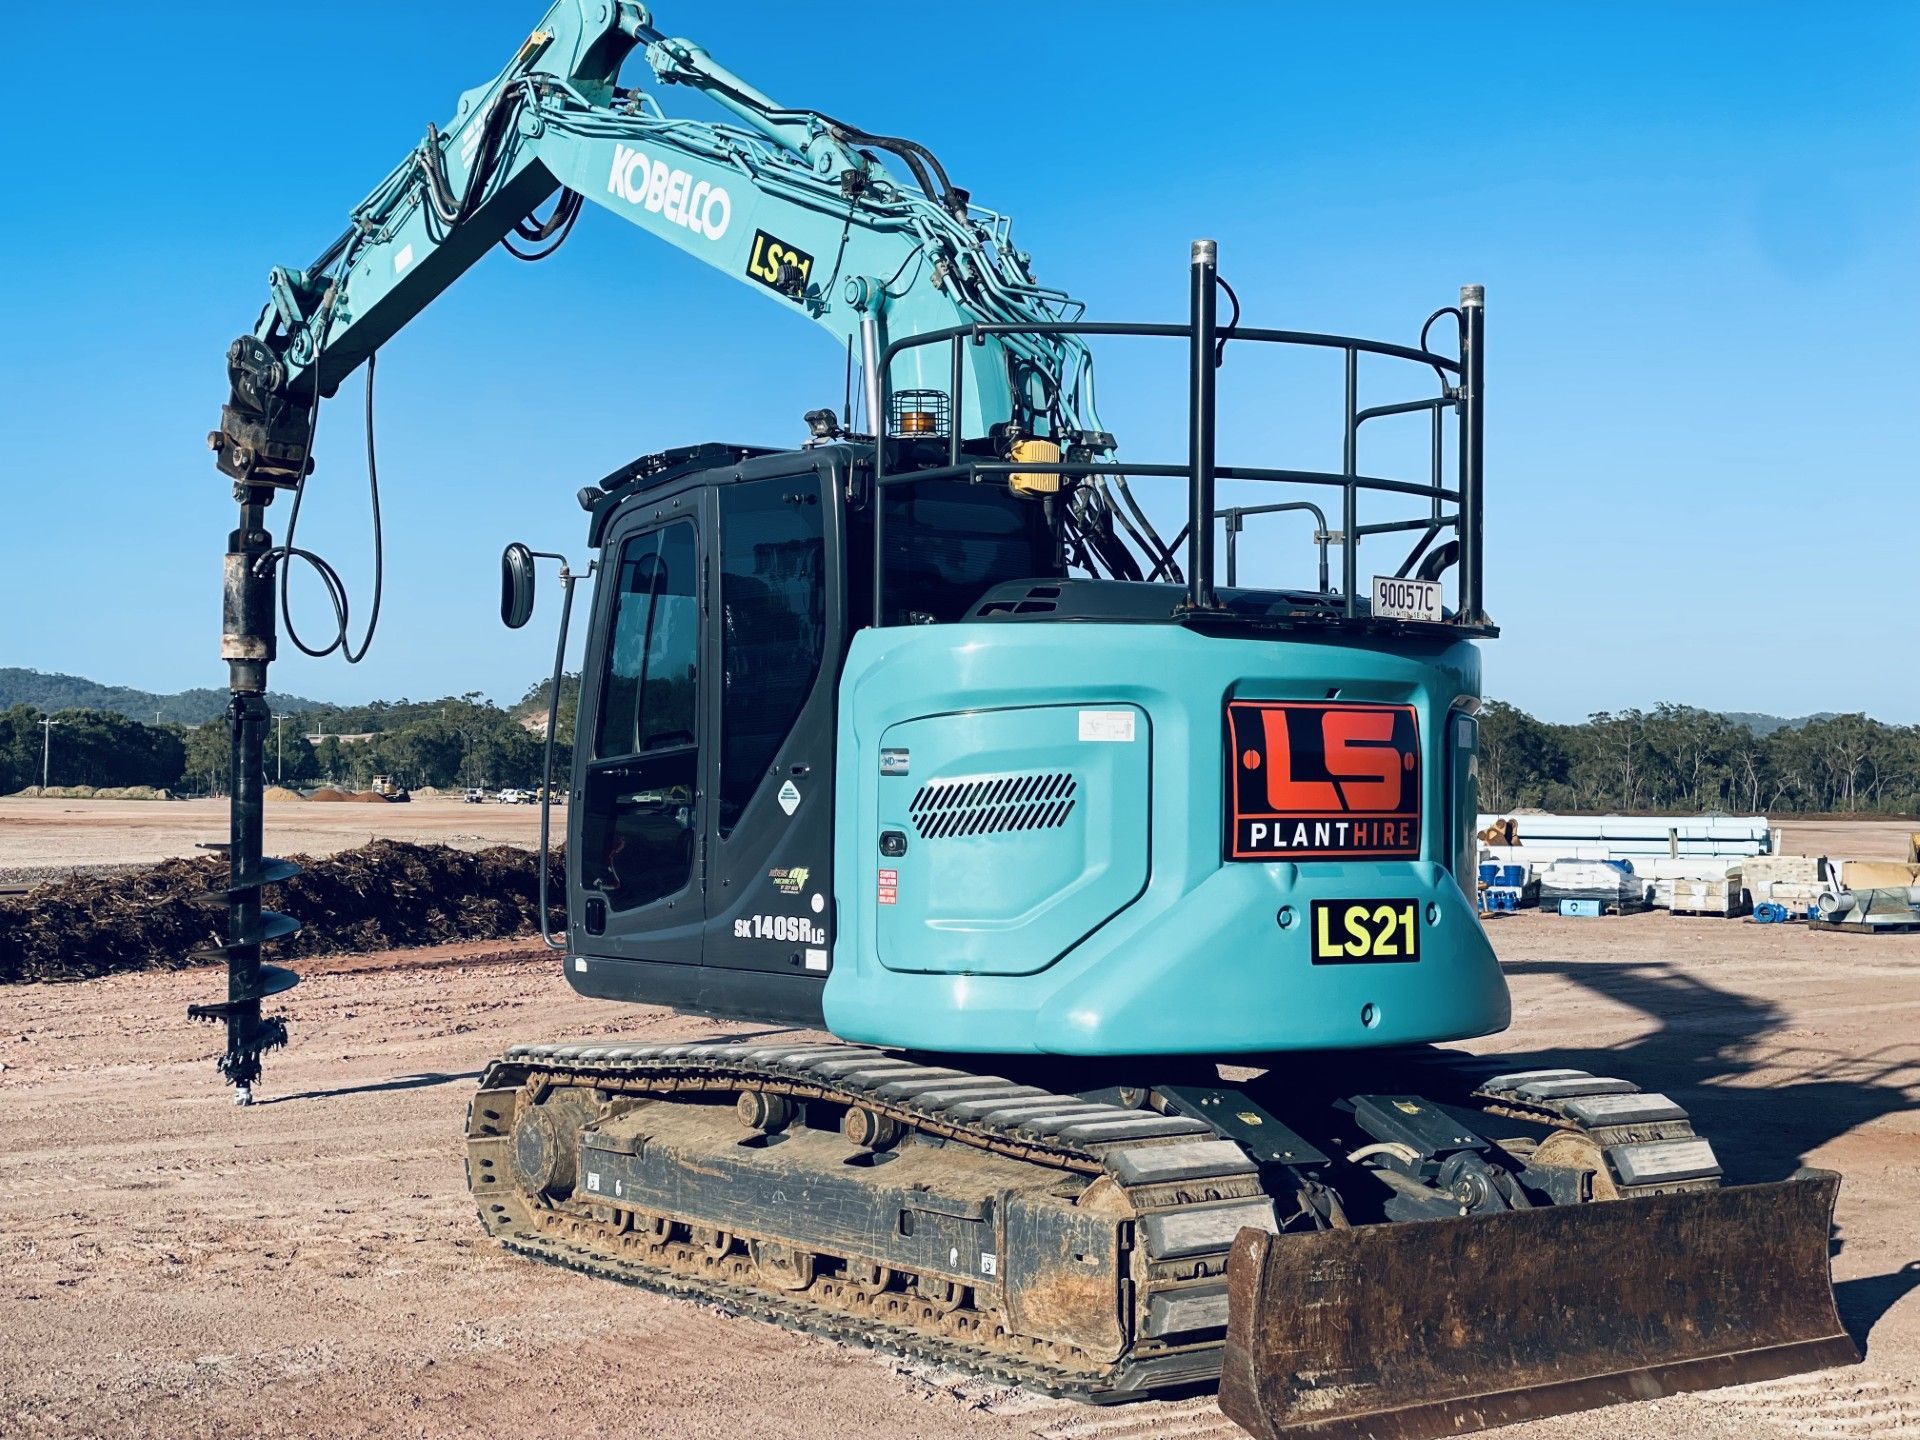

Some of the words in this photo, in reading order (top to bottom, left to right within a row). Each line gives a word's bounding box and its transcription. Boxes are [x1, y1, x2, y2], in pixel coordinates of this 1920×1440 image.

[608, 143, 731, 240] KOBELCO
[1380, 582, 1433, 611] 90057C
[1261, 710, 1401, 810] LS
[1318, 905, 1414, 957] LS21
